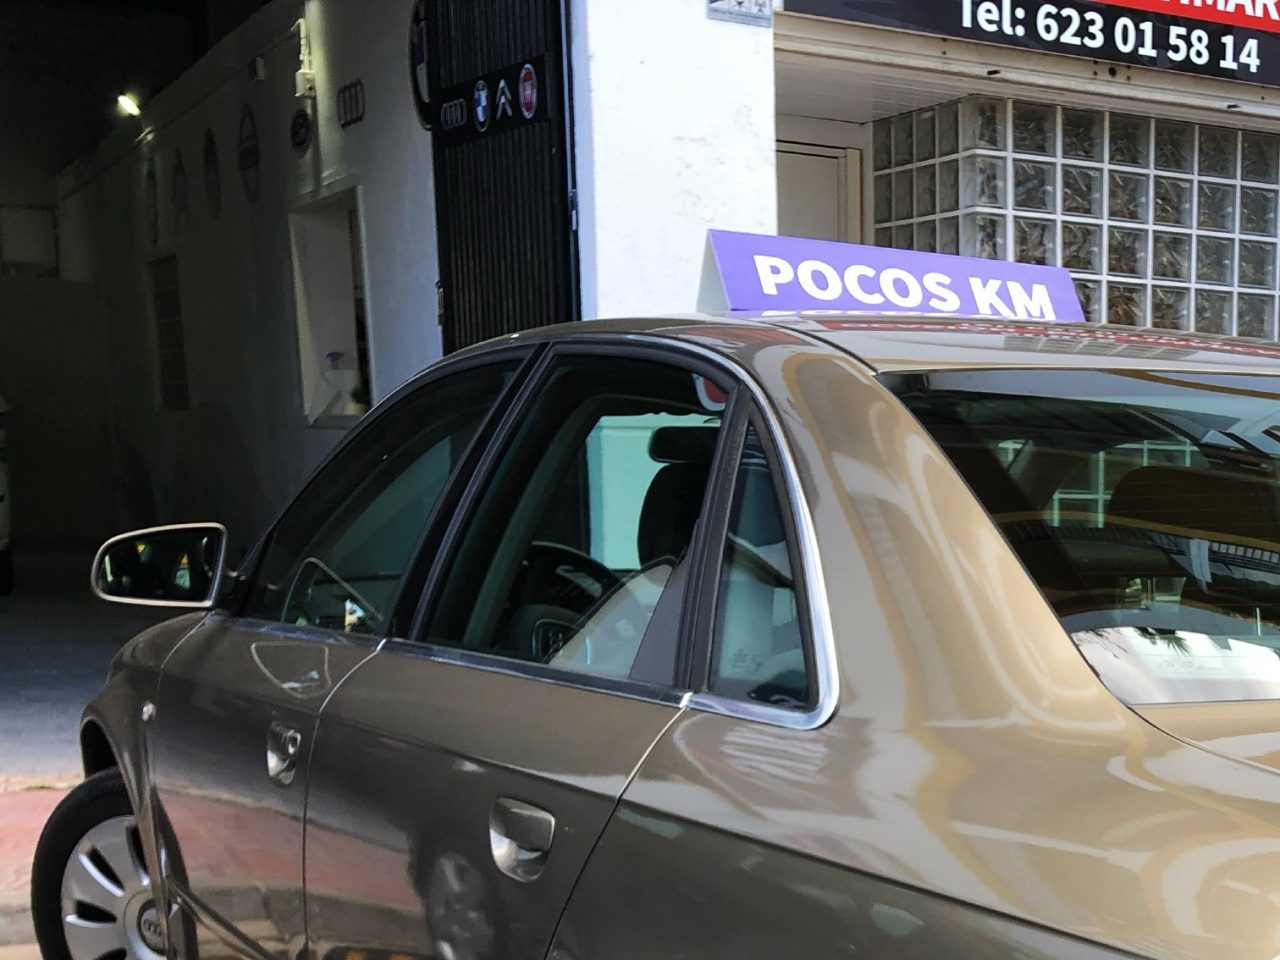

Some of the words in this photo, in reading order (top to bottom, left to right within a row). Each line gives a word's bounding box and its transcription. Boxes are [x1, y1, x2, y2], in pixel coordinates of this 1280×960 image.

[959, 0, 1026, 37] Tel:
[1035, 4, 1105, 48] 623
[1114, 16, 1157, 58] 01
[1167, 26, 1210, 66] 58
[1218, 33, 1261, 73] 14
[753, 254, 961, 312] POCOS
[968, 276, 1057, 321] KM
